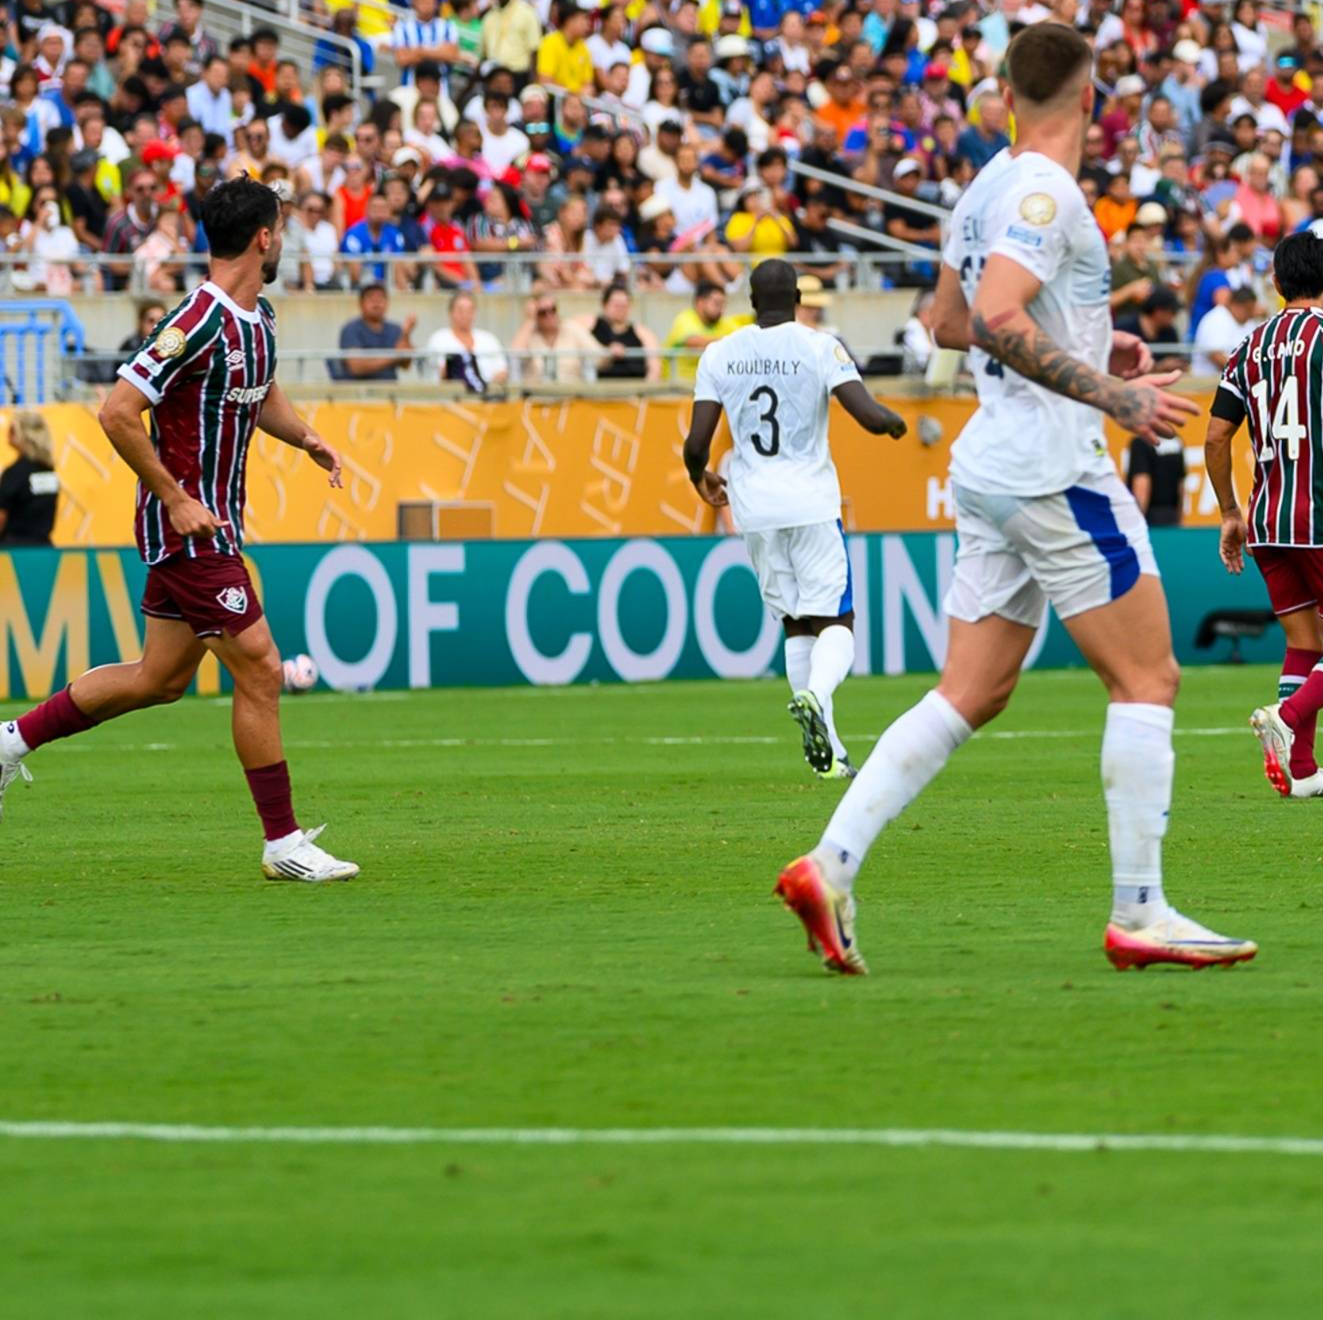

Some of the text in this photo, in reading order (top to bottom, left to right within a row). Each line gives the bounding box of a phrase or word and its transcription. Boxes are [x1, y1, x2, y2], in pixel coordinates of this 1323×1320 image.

[749, 385, 780, 457] 3
[1251, 376, 1307, 462] 14
[305, 544, 466, 692] OF
